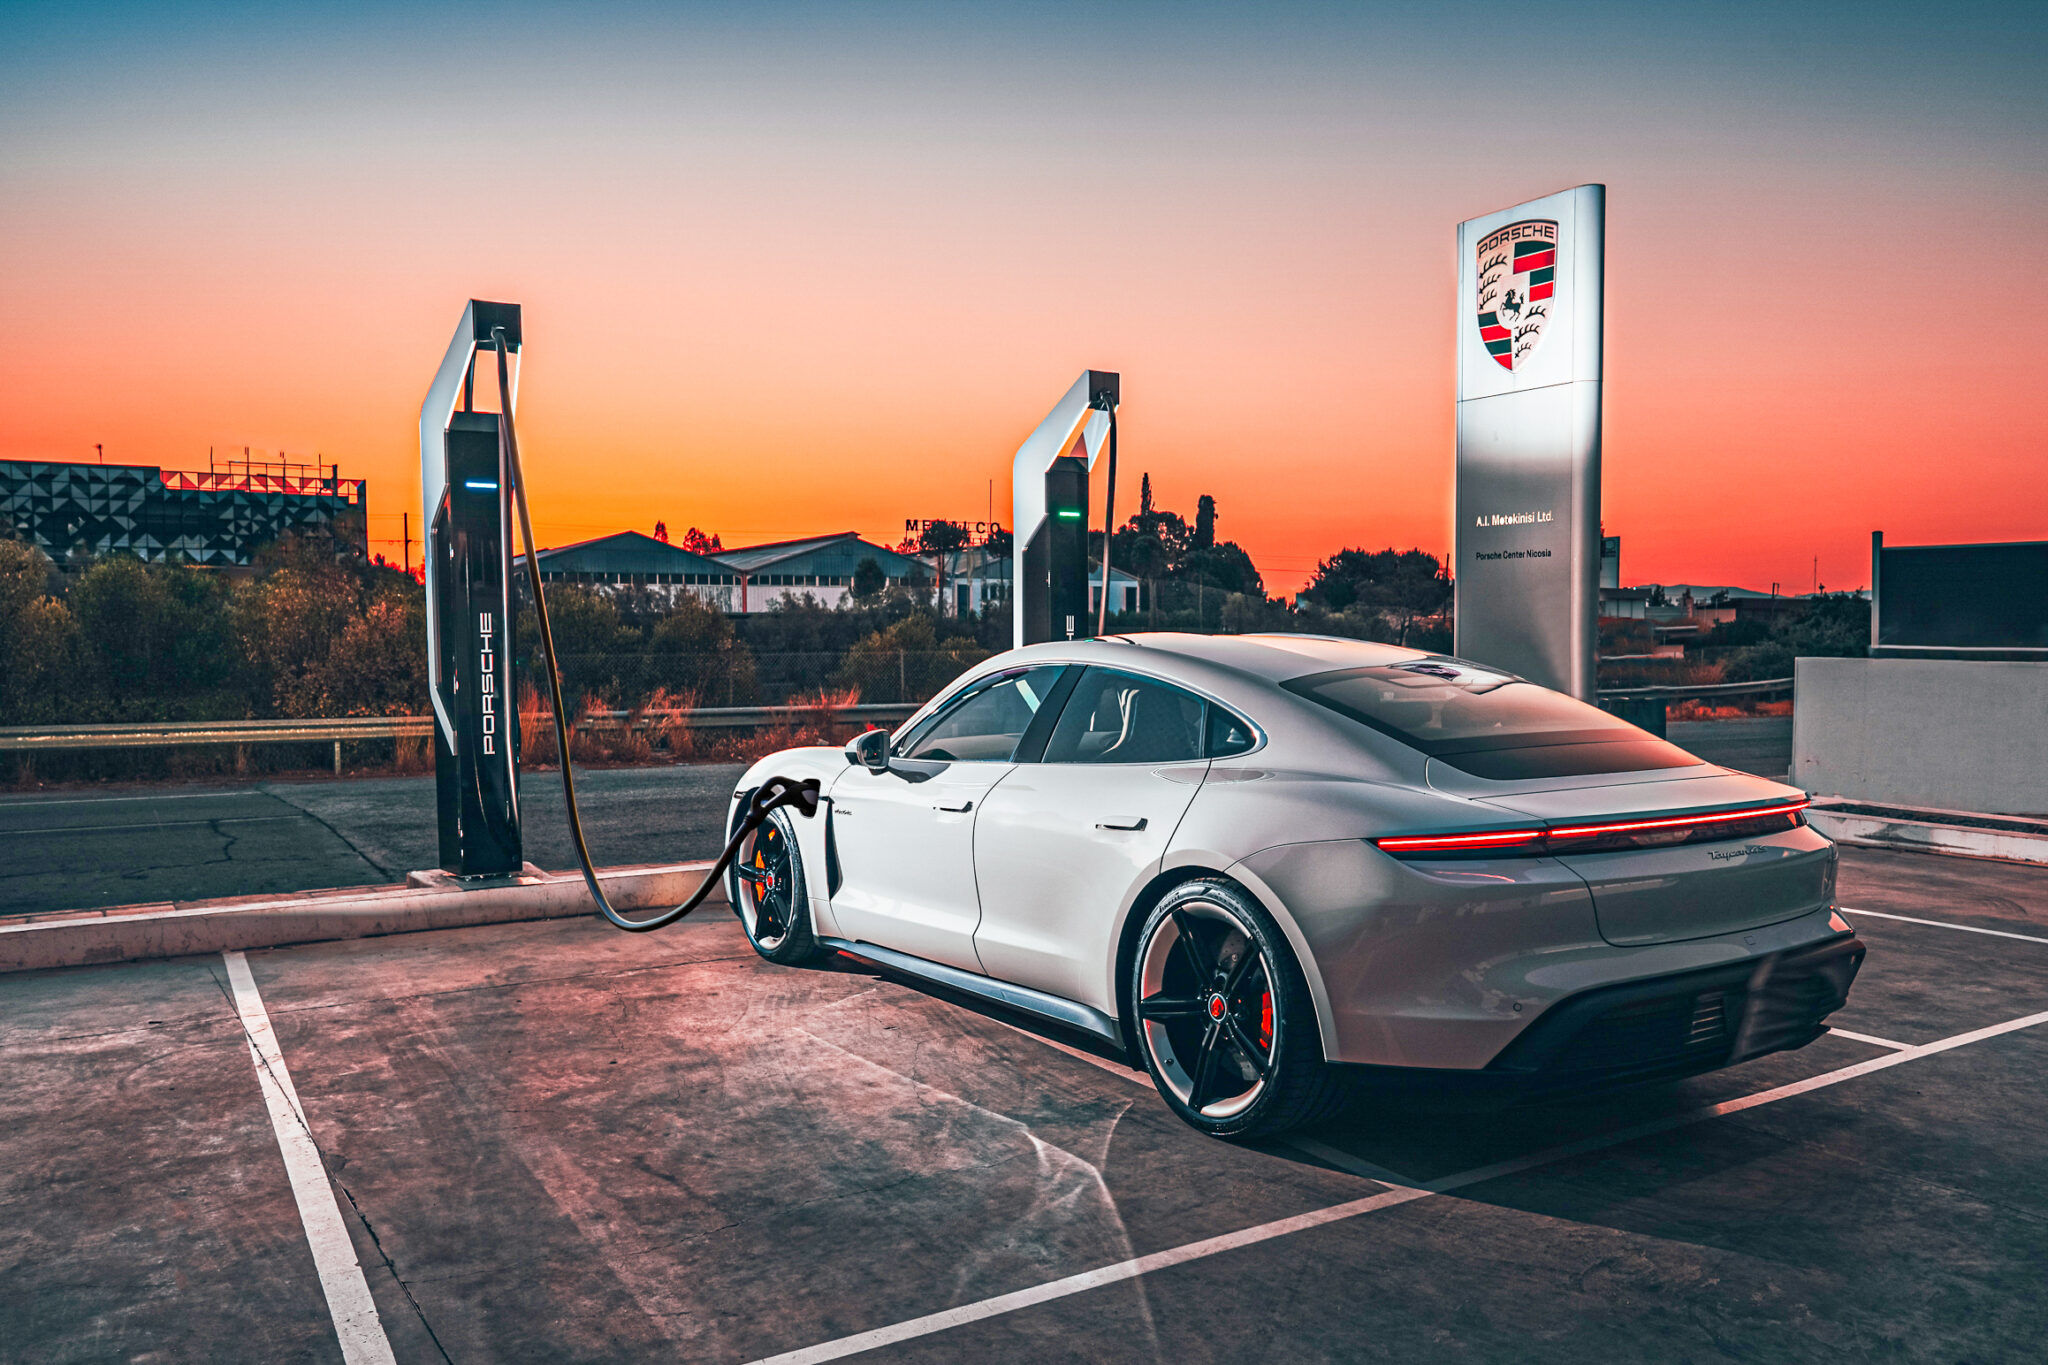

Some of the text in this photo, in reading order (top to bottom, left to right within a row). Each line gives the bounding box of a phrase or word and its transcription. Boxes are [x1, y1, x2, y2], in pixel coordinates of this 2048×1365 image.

[1479, 225, 1554, 258] PORSCHE
[1537, 510, 1554, 522] Ltd.
[1475, 548, 1552, 560] Porsche Center Nicosia
[480, 612, 495, 755] PORSCHE
